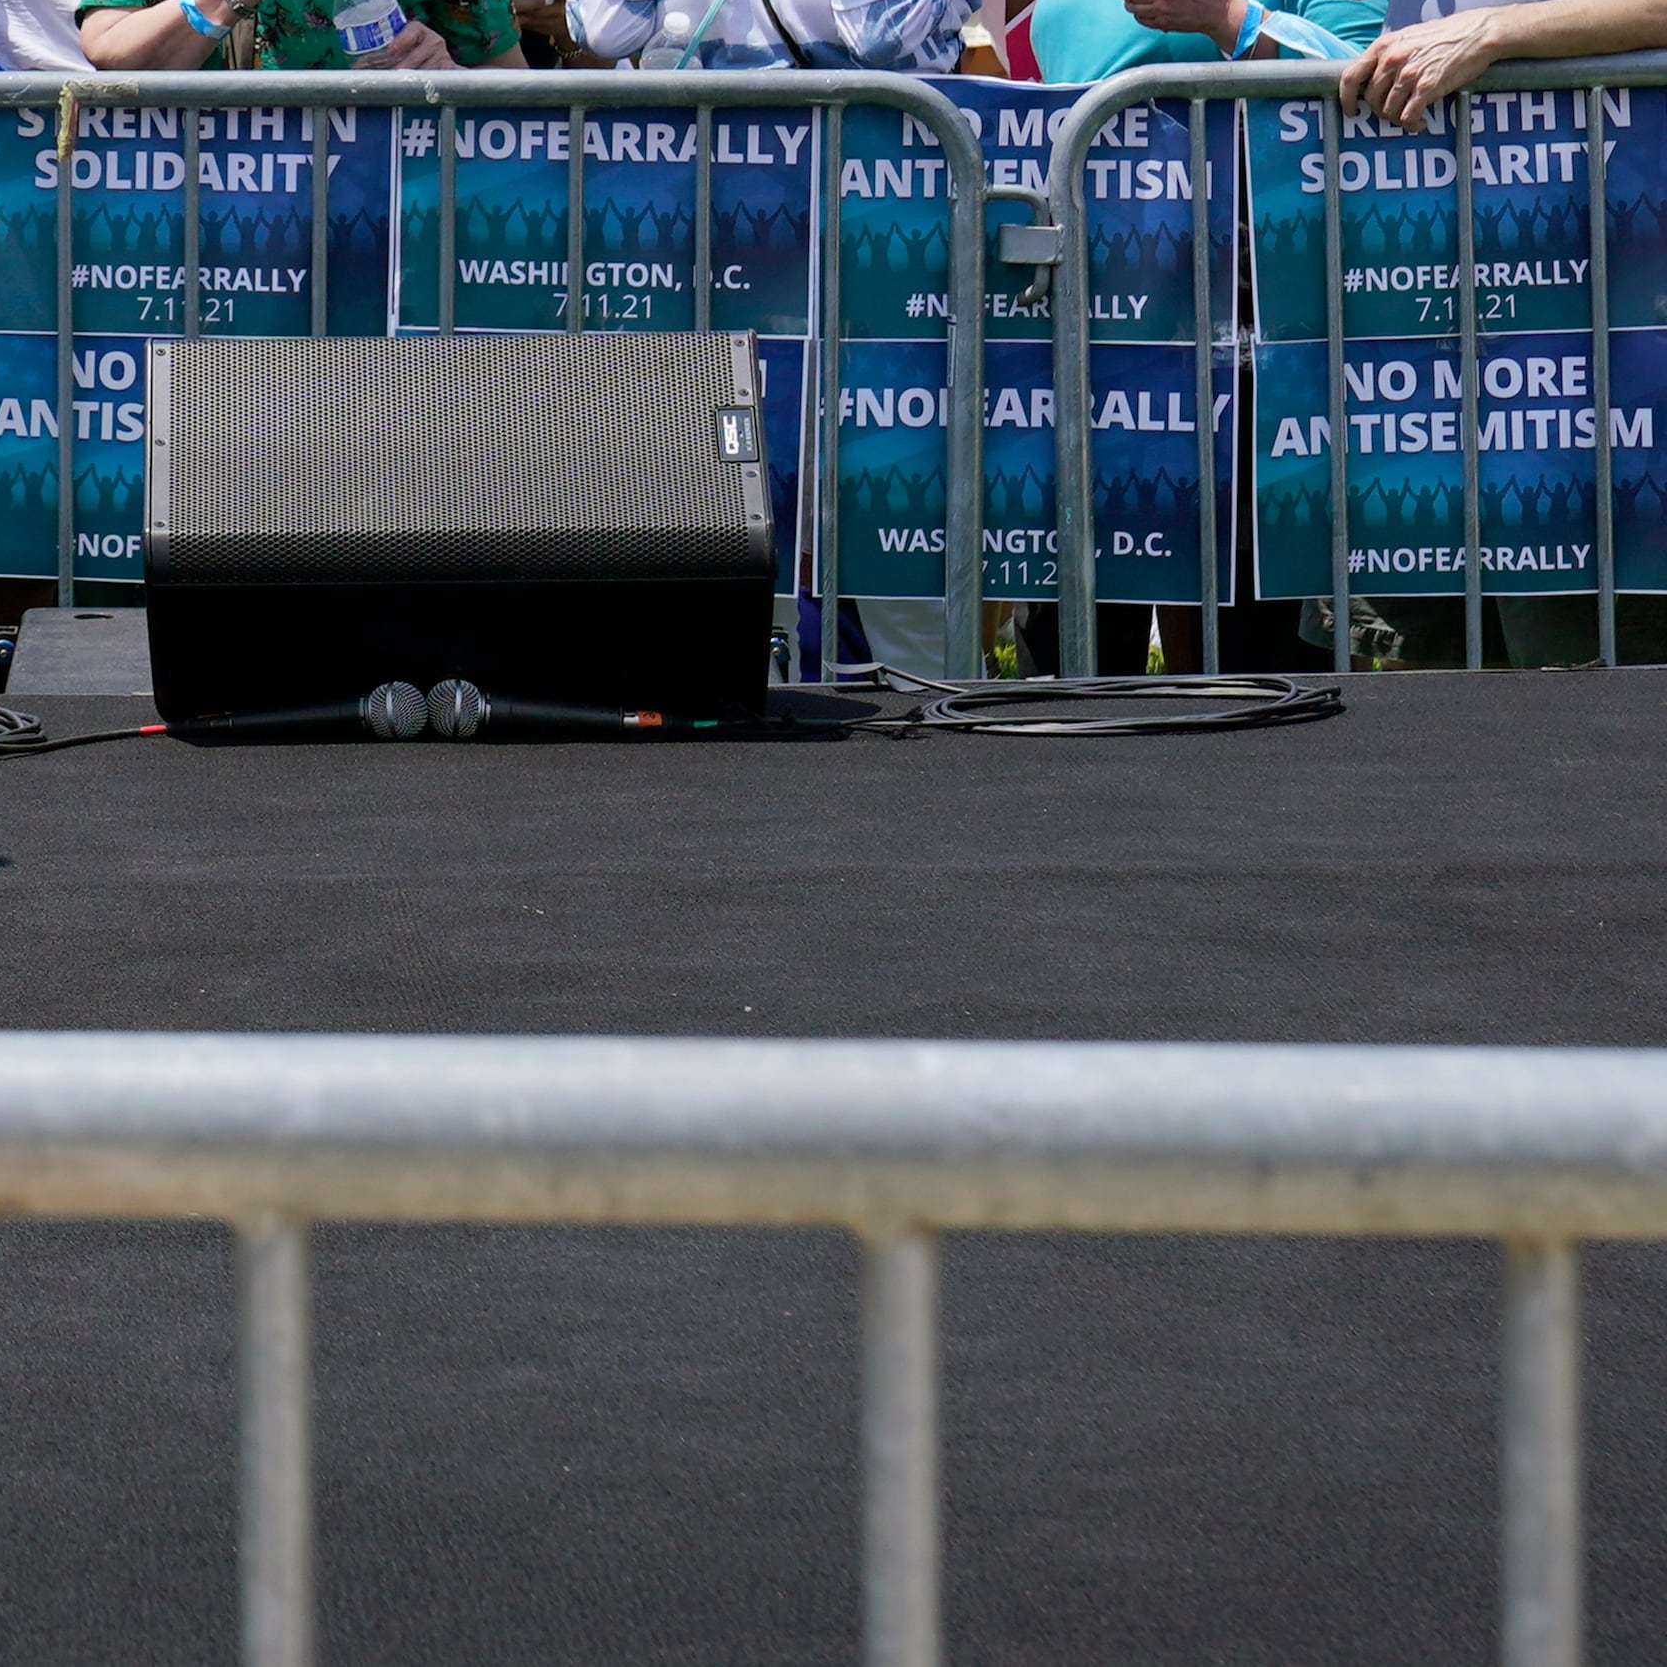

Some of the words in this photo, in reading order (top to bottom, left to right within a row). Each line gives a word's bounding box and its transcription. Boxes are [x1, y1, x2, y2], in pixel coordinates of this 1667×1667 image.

[1343, 361, 1418, 402] NO
[1433, 356, 1587, 399] MORE
[723, 415, 740, 454] QSC
[1113, 531, 1171, 557] D.C.
